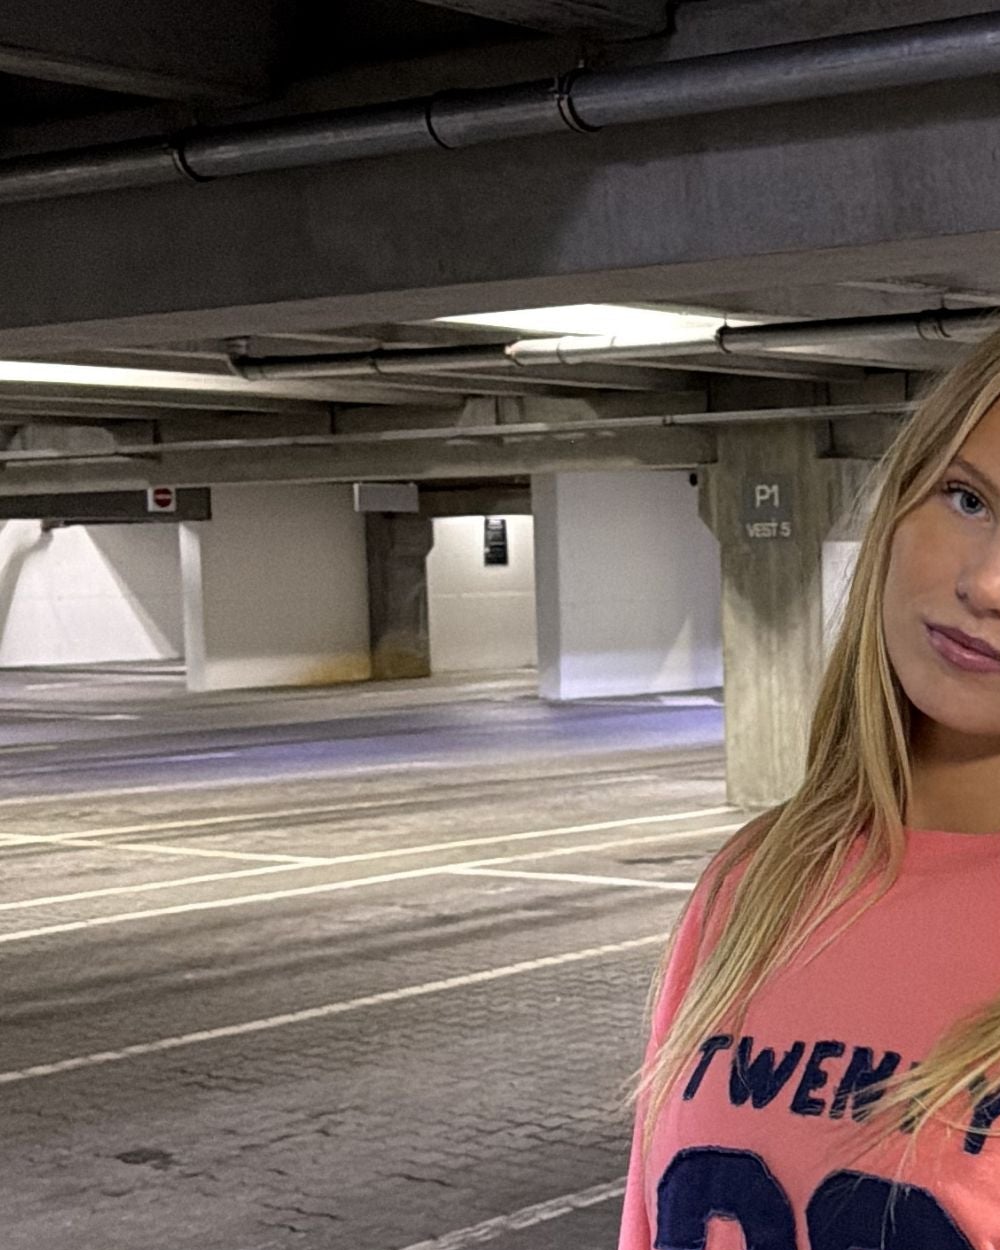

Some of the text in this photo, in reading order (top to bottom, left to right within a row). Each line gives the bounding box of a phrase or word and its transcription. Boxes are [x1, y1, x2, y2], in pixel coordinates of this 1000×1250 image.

[755, 484, 780, 508] P1
[746, 522, 791, 538] VEST 5
